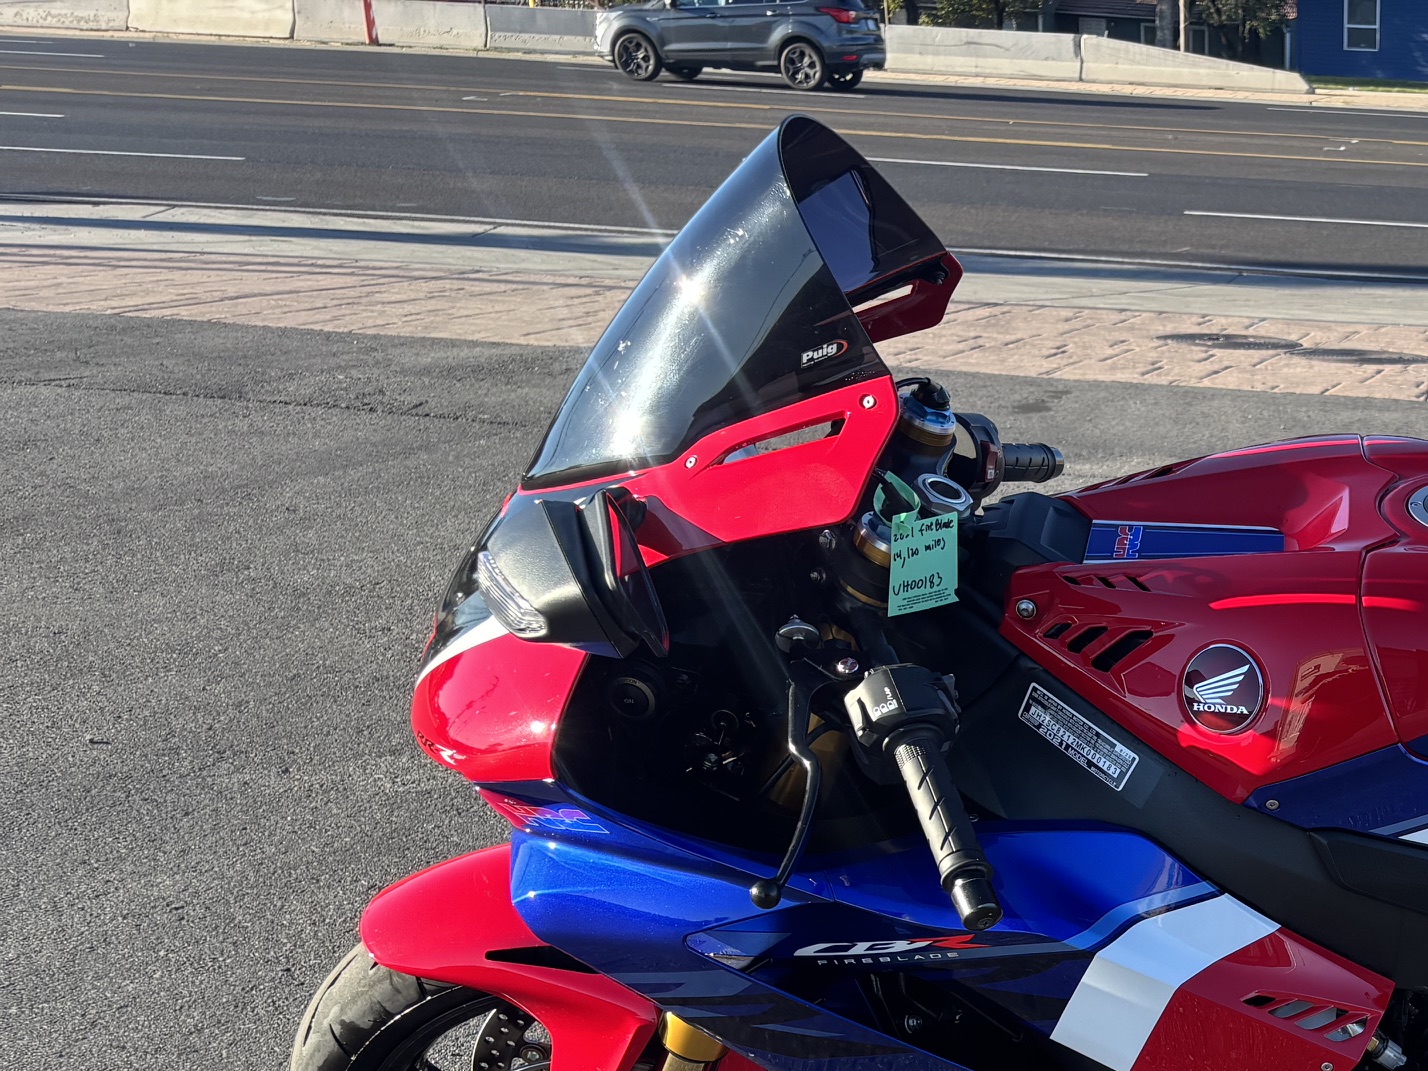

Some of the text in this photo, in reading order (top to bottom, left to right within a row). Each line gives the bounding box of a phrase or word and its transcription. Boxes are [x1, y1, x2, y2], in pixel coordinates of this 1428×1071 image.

[802, 343, 838, 364] Puig
[1192, 702, 1249, 715] HONDA
[1039, 725, 1066, 749] 2021
[1068, 747, 1088, 767] MODEL
[793, 934, 992, 957] CBR
[817, 952, 960, 966] FIREBLADE
